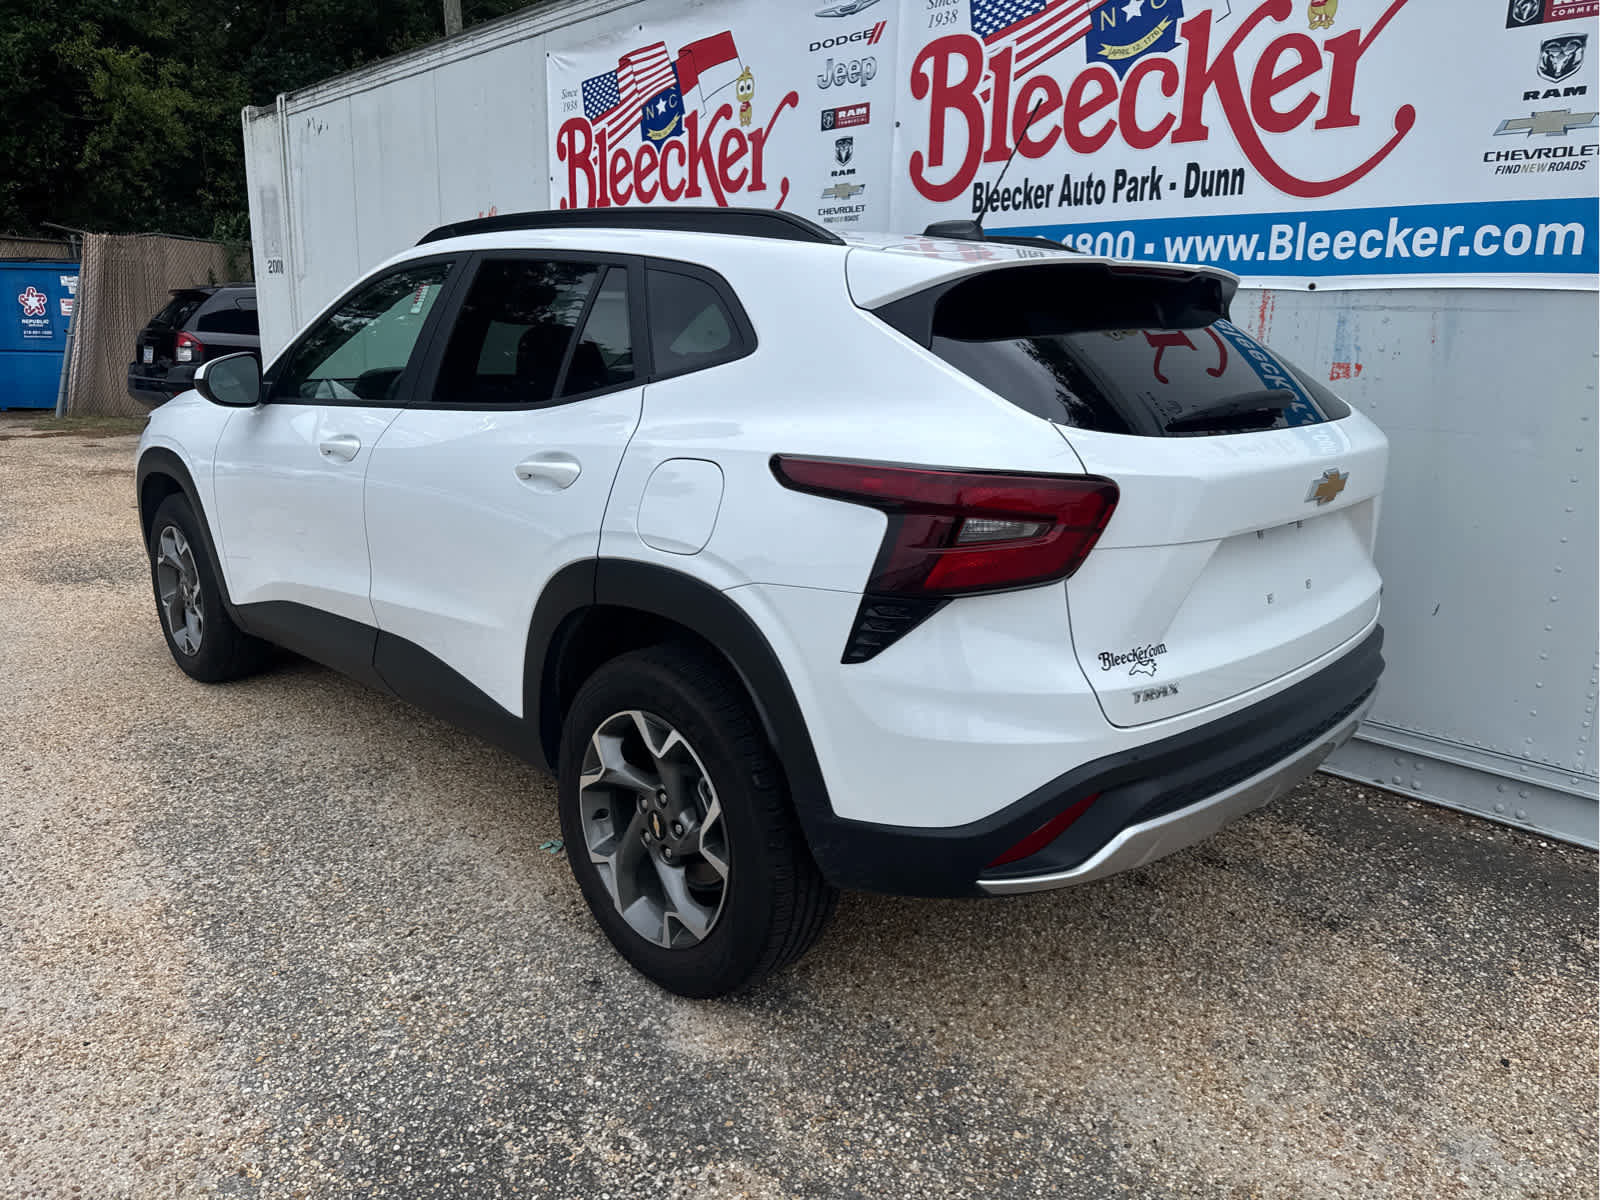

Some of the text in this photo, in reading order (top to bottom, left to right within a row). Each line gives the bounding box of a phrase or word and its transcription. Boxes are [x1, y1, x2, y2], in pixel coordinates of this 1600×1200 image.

[928, 9, 959, 28] 1938
[809, 28, 876, 52] DODGE
[816, 56, 877, 90] Jeep
[1522, 85, 1588, 101] RAM
[838, 107, 867, 119] RAM
[831, 168, 857, 177] RAM
[971, 162, 1245, 214] Bleecker Auto Park Dunn
[817, 204, 865, 216] CHEVROLET
[1163, 217, 1585, 263] www.Bleecker.com
